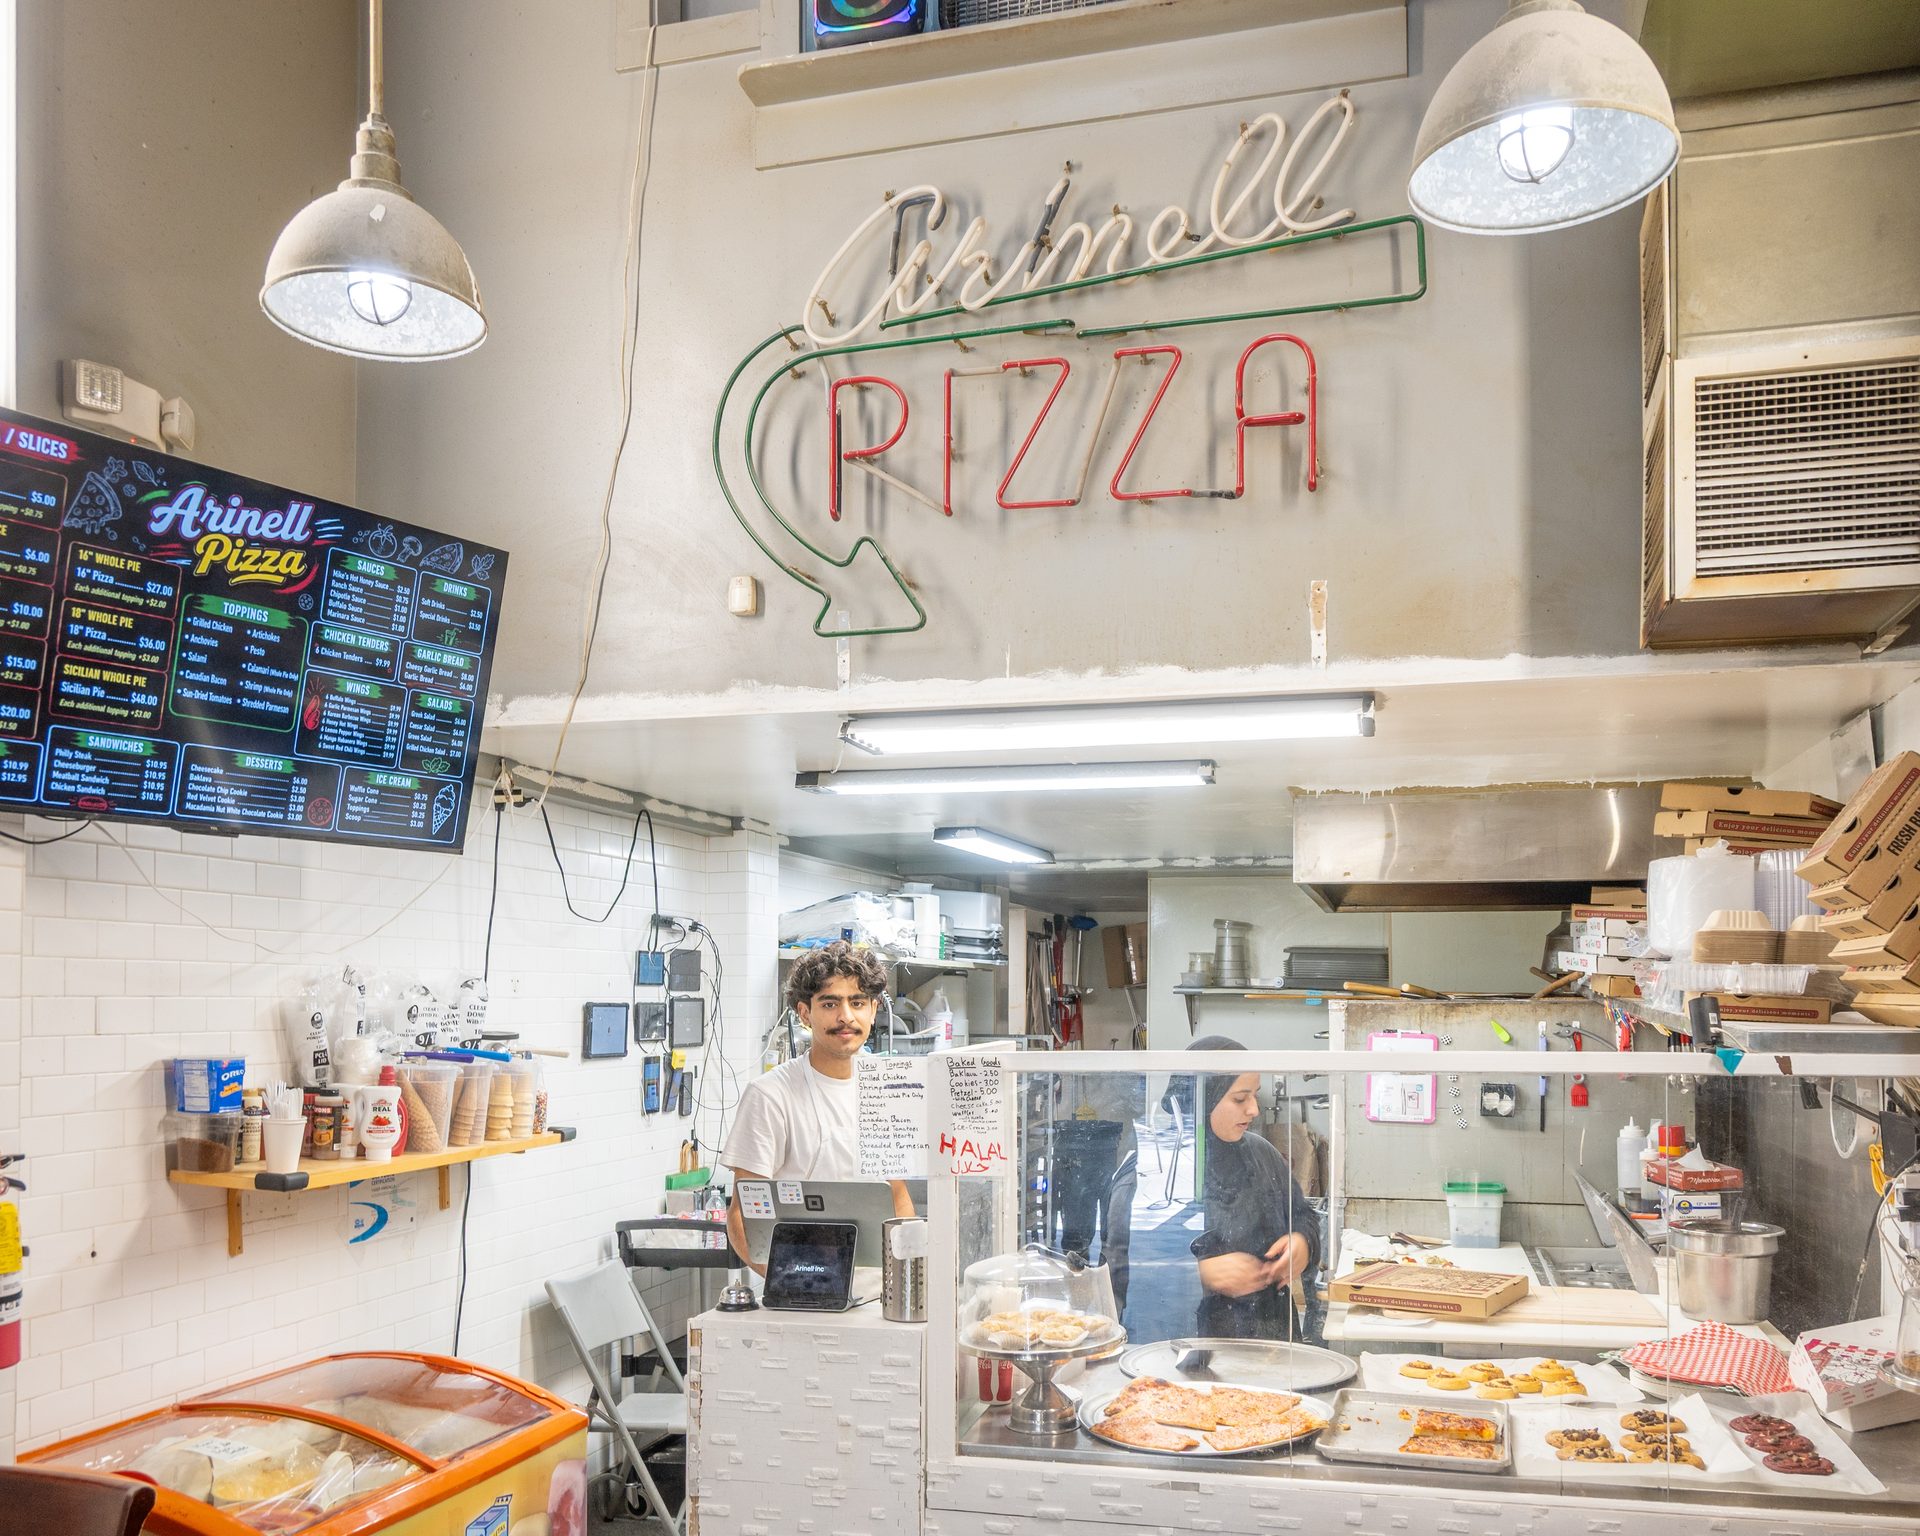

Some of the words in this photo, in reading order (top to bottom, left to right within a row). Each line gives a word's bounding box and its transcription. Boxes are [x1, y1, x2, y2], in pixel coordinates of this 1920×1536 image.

[804, 97, 1357, 345] Arinell
[829, 334, 1318, 520] PIZZA
[18, 432, 68, 459] SLICES
[31, 491, 56, 507] $5.00
[149, 486, 314, 543] Arinell
[24, 548, 50, 563] $6.00
[78, 549, 93, 561] 16"
[95, 552, 126, 569] WHOLE
[126, 562, 142, 573] PIE
[194, 533, 307, 576] Pizza
[357, 560, 385, 576] SAUCES
[76, 567, 91, 578] 16"
[92, 569, 114, 584] Pizza
[146, 582, 173, 596] $27.00
[443, 582, 468, 597] DRINKS
[74, 583, 90, 592] Each
[91, 586, 121, 599] additional
[122, 594, 144, 606] topping
[146, 599, 167, 609] +$2.00
[330, 589, 351, 601] Chipotle
[352, 594, 367, 604] Sauce
[394, 604, 408, 614] $1.00
[13, 602, 43, 618] $10.00
[71, 607, 86, 618] 18"
[88, 610, 117, 626] WHOLE
[119, 617, 134, 629] PIE
[223, 602, 269, 623] TOPPINGS
[192, 617, 210, 628] Grilled
[212, 621, 233, 634] Chicken
[69, 624, 84, 635] 18"
[85, 627, 107, 640] Pizza
[139, 637, 166, 651] $36.00
[190, 634, 219, 648] Anchovies
[252, 629, 280, 643] Artichokes
[324, 628, 356, 644] CHICKEN
[358, 636, 390, 651] TENDERS
[187, 651, 208, 664] Salami
[250, 645, 266, 657] Pesto
[417, 649, 442, 662] GARLIC
[443, 654, 465, 667] BREAD
[6, 655, 37, 670] $15.00
[63, 664, 101, 680] SICILIAN
[102, 670, 132, 685] WHOLE
[133, 676, 147, 688] PIE
[185, 669, 210, 682] Canadian
[210, 674, 227, 686] Bacon
[61, 681, 91, 696] Sicilian
[92, 686, 105, 698] Pie
[131, 692, 158, 706] $48.00
[245, 680, 263, 692] Shrimp
[346, 681, 371, 696] WINGS
[183, 688, 208, 701] Sun-Dried
[209, 692, 233, 705] Tomatoes
[427, 698, 453, 710] SALADS
[0, 705, 31, 720] $20.00
[242, 697, 265, 710] Shredded
[265, 701, 289, 714] Parmesan
[88, 735, 144, 753] SANDWICHES
[55, 748, 74, 760] Philly
[74, 750, 93, 760] Steak
[145, 759, 168, 770] $10.95
[245, 756, 284, 771] DESSERTS
[53, 760, 97, 773] Cheeseburger
[144, 770, 166, 780] $10.95
[190, 763, 224, 775] Cheesecake
[293, 776, 308, 785] $6.00
[51, 771, 80, 782] Meatball
[80, 774, 110, 785] Sandwich
[143, 781, 165, 791] $10.95
[189, 773, 212, 783] Baklava
[291, 785, 307, 794] $2.50
[375, 774, 387, 785] ICE
[388, 775, 412, 788] CREAM
[50, 782, 76, 792] Chicken
[76, 785, 106, 795] Sandwich
[141, 791, 163, 802] $10.95
[188, 783, 216, 793] Chocolate
[216, 785, 229, 795] Chip
[230, 787, 248, 797] Cookie
[290, 795, 306, 804] $3.00
[186, 791, 198, 801] Red
[199, 794, 216, 803] Velvet
[217, 796, 236, 805] Cookie
[288, 803, 304, 812] $3.00
[185, 802, 215, 812] Macadamia
[216, 805, 226, 814] Nut
[226, 806, 241, 816] White
[242, 808, 266, 818] Chocolate
[267, 811, 284, 820] Cookie
[287, 812, 303, 821] $3.00
[1717, 821, 1740, 831] Enjoy
[1741, 823, 1760, 832] your
[1761, 825, 1795, 834] delicious
[1847, 842, 1863, 858] Enjoy
[1863, 827, 1874, 842] your
[1874, 801, 1895, 827] delicious
[1887, 823, 1917, 857] FRESH
[1720, 1007, 1733, 1015] njoy
[857, 1060, 878, 1071] New
[946, 1056, 976, 1068] Baked
[980, 1056, 1001, 1067] Goods
[859, 1073, 880, 1082] Grilled
[883, 1073, 907, 1082] Chicken
[949, 1069, 978, 1078] Baklava
[858, 1082, 883, 1094] Shrimp
[949, 1078, 978, 1087] Cookies
[950, 1087, 974, 1097] Pretzel
[890, 1114, 912, 1123] Bacon
[859, 1123, 890, 1132] Sun-Dried
[895, 1141, 930, 1149] Parmesan
[939, 1131, 1008, 1161] HALAL
[860, 1149, 880, 1159] Pesto
[884, 1150, 905, 1159] Sauce
[950, 1159, 990, 1175] حلال
[794, 1264, 815, 1273] Arinell
[815, 1265, 825, 1273] Inc
[1352, 1294, 1372, 1304] Enjoy
[1373, 1297, 1390, 1305] your
[1391, 1298, 1422, 1308] delicious
